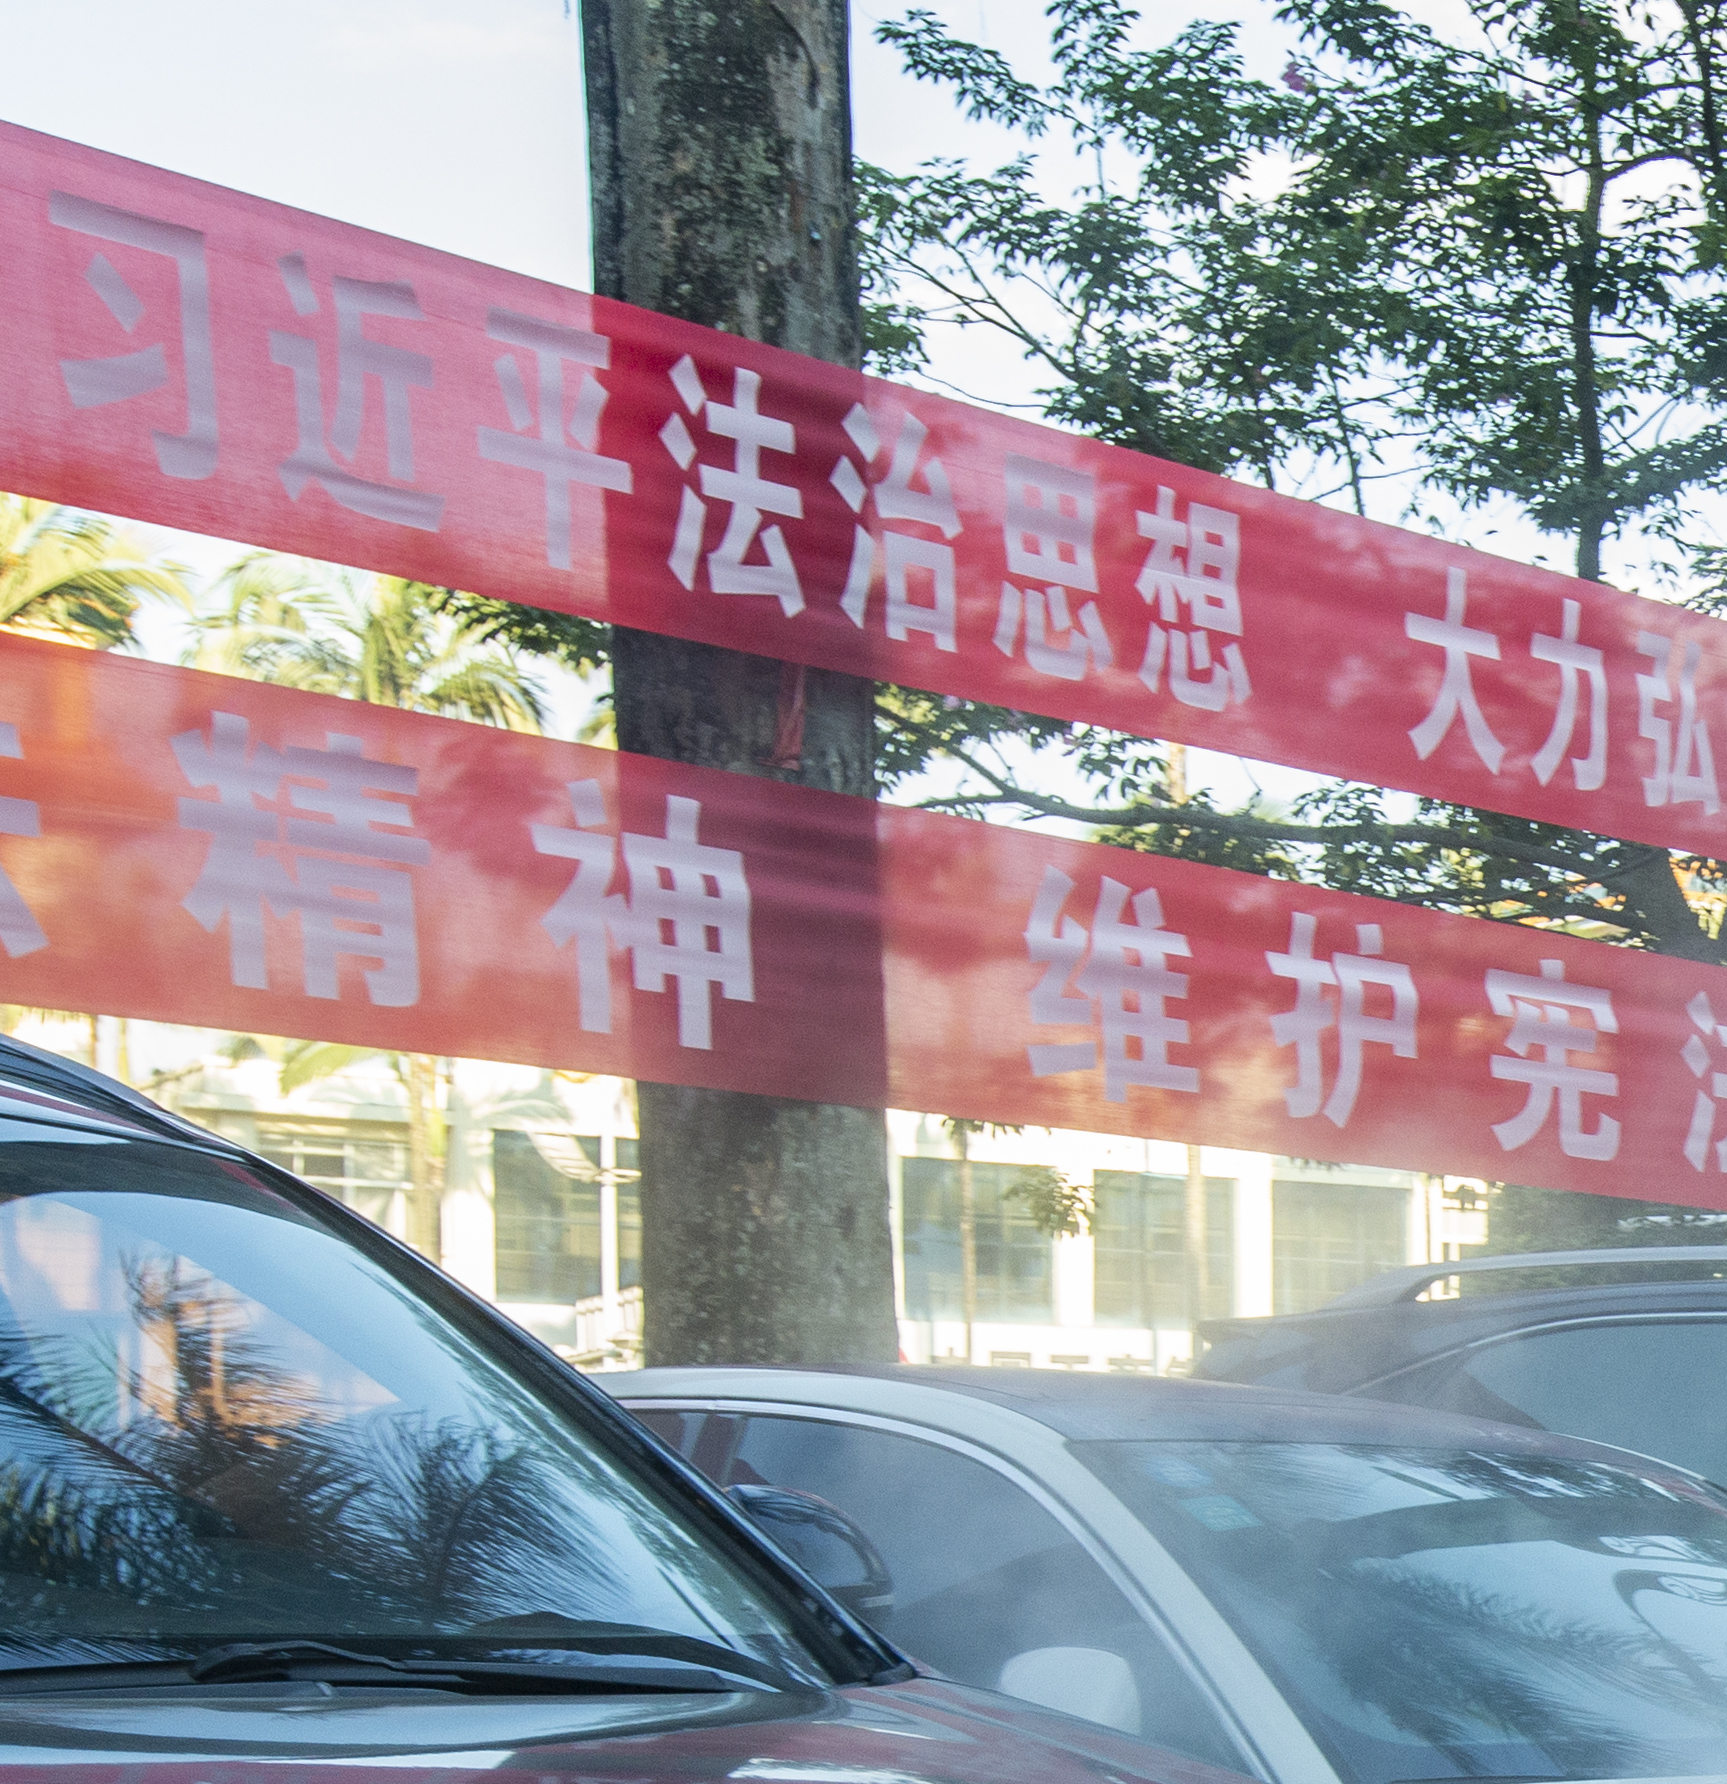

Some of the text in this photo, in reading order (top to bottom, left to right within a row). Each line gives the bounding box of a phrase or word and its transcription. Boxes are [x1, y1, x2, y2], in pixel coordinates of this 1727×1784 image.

[48, 190, 1252, 712] 习近平法治思想
